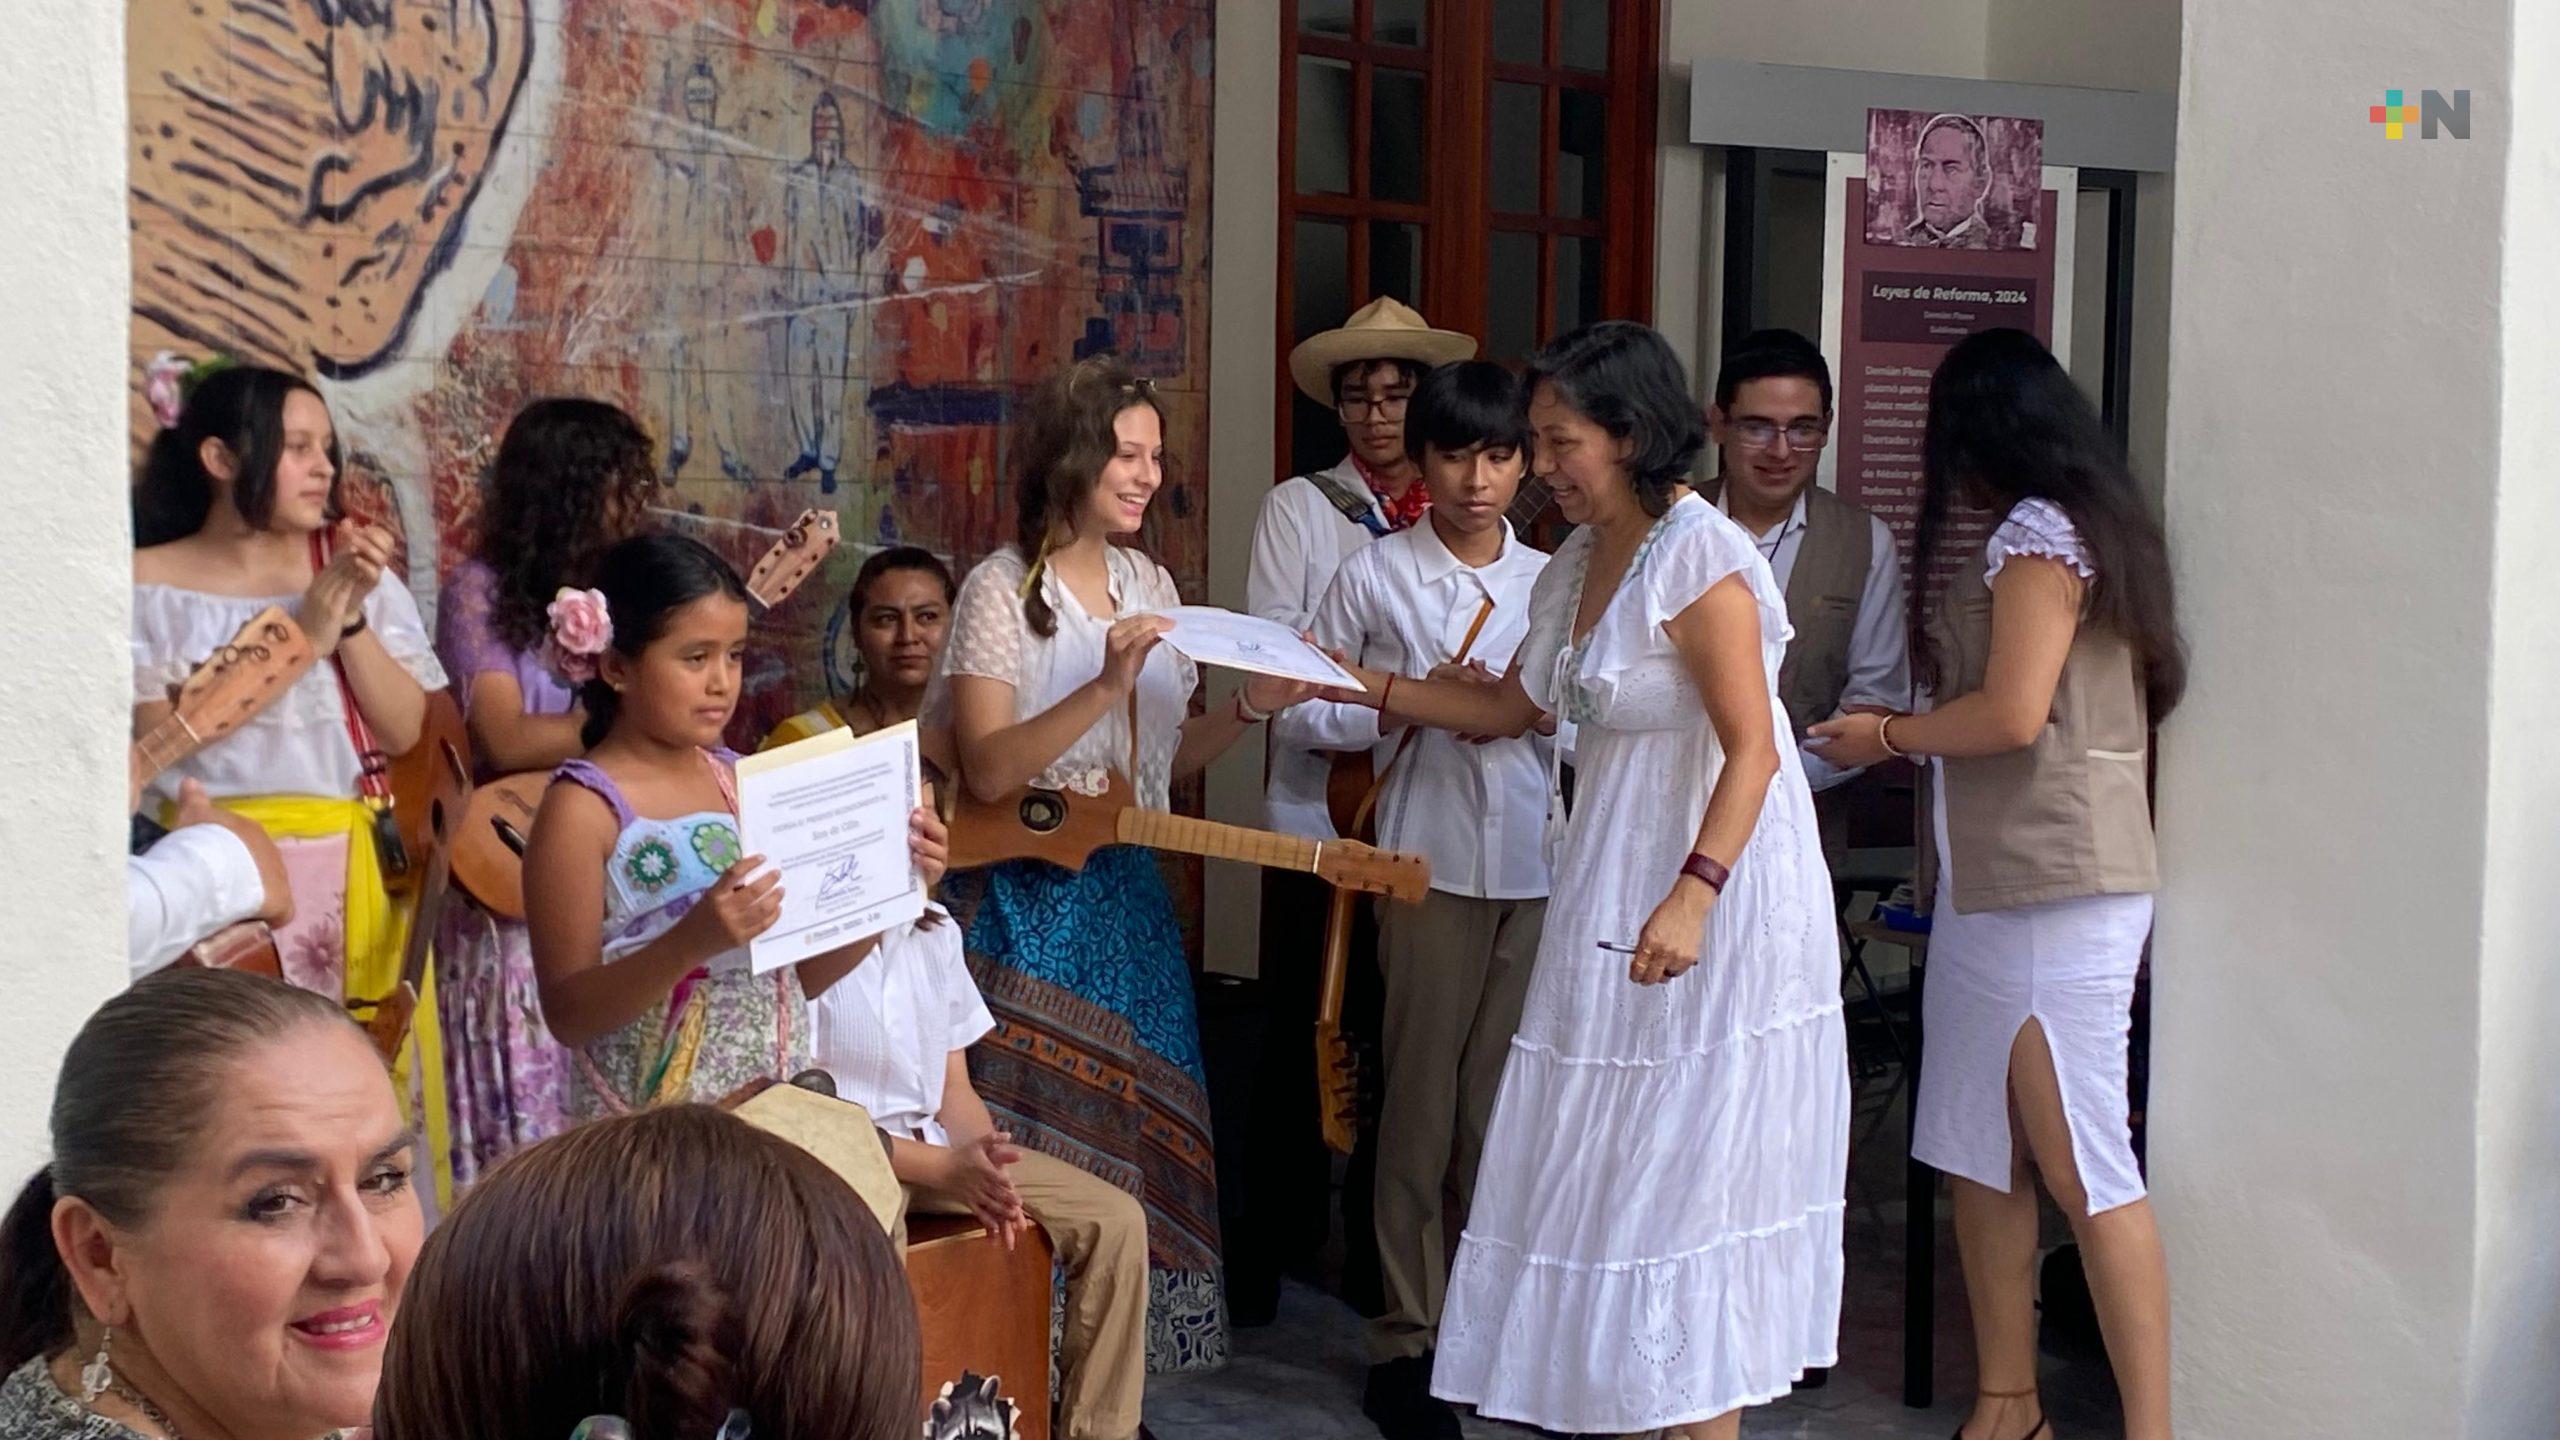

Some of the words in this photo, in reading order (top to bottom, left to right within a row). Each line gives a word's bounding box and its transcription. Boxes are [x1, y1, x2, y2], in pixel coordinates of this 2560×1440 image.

[1872, 284, 1910, 301] Leyes
[1913, 285, 1930, 299] de
[1932, 286, 1994, 304] Reforma,
[1994, 290, 2028, 304] 2024
